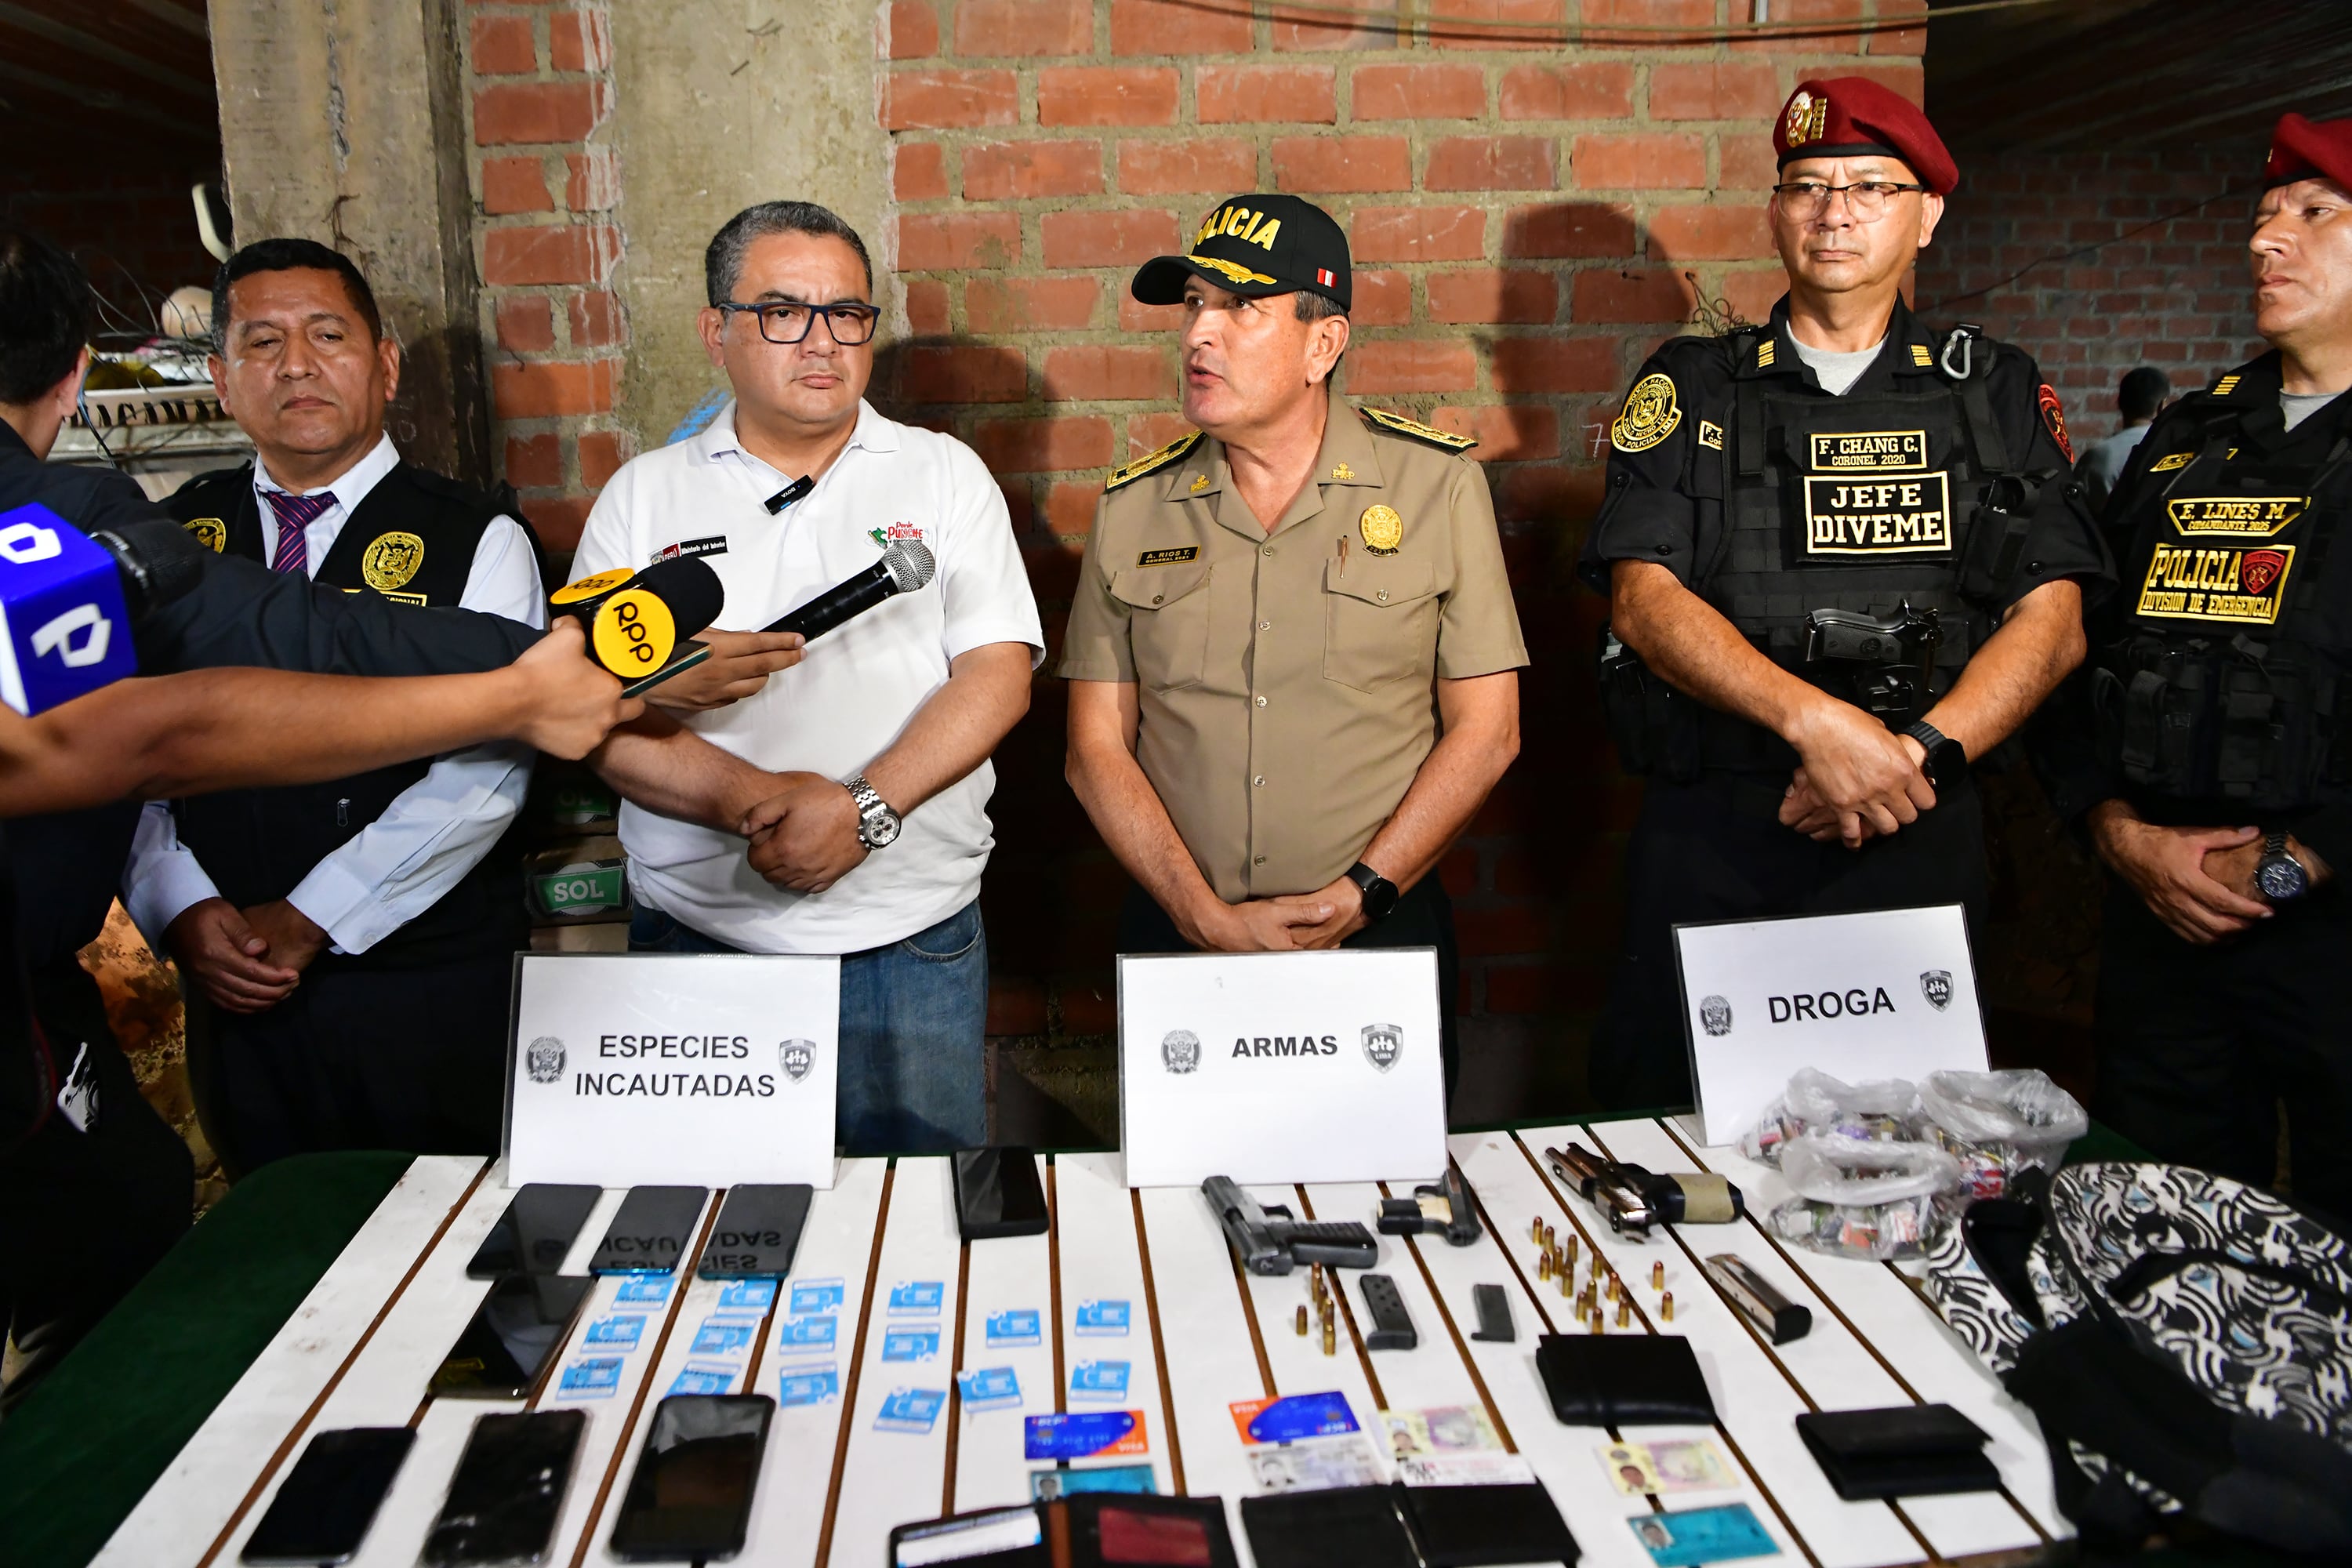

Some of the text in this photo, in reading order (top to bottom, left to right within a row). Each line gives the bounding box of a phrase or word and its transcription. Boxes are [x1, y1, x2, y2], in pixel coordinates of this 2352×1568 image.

[1625, 434, 1660, 448] POLICIAL
[1661, 417, 1676, 435] LIMA
[1819, 436, 1918, 455] F. CHANG C.
[1831, 454, 1906, 466] CORONEL 2020
[1831, 483, 1922, 509] JEFE
[2179, 503, 2195, 520] E.
[2202, 503, 2261, 520] LINES
[1813, 510, 1944, 545] DIVEME
[2187, 521, 2247, 531] COMANDANTE
[2148, 550, 2241, 591] POLICIA
[2143, 591, 2273, 618] DIVISION DE EMERGENCIA
[554, 879, 604, 903] SOL
[1768, 986, 1896, 1024] DROGA
[599, 1035, 750, 1059] ESPECIES
[1232, 1035, 1338, 1058] ARMAS
[575, 1073, 775, 1098] INCAUTADAS
